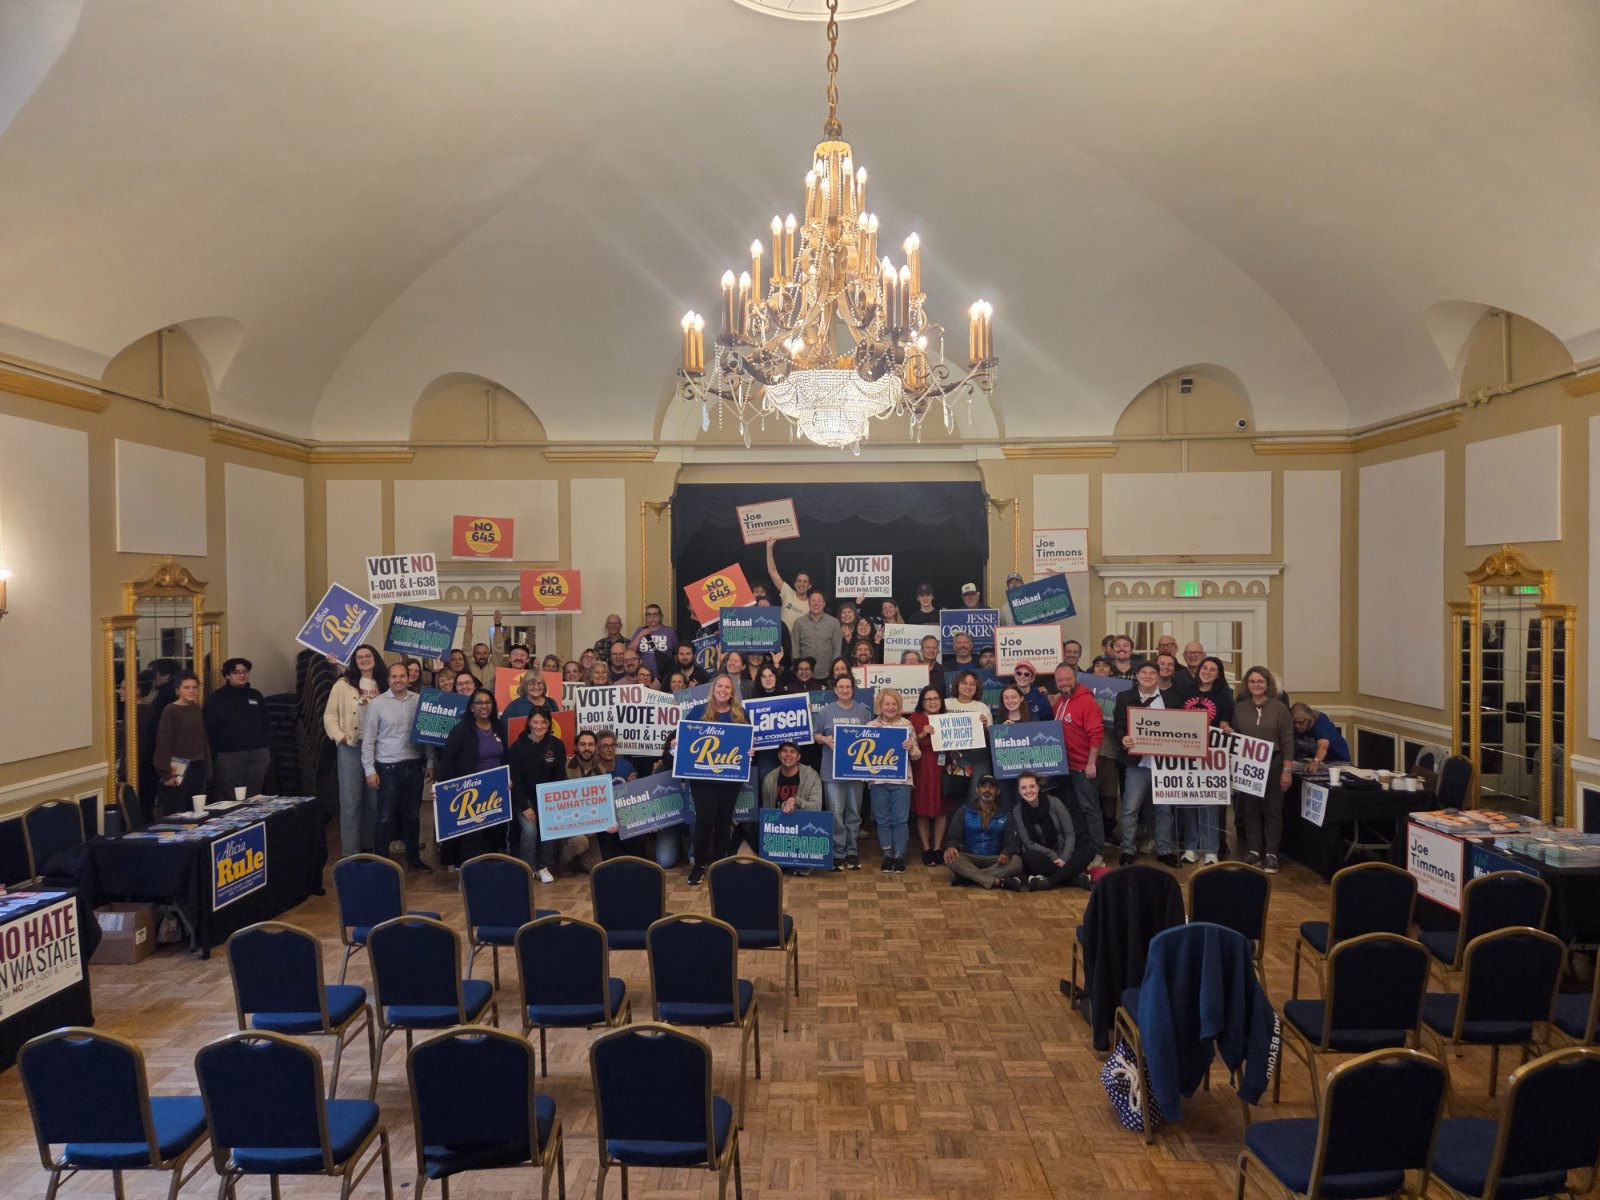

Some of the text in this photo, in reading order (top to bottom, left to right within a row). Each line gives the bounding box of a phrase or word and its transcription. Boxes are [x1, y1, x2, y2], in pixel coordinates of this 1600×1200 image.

[743, 513, 761, 521] Joe
[744, 518, 790, 529] Timmons
[474, 522, 493, 532] NO
[471, 532, 495, 542] 645
[1036, 539, 1055, 547] Joe
[1036, 549, 1082, 557] Timmons
[368, 555, 434, 576] VOTE NO
[838, 557, 890, 572] VOTE NO
[371, 576, 436, 591] I-001 & I-638
[541, 576, 560, 585] NO
[706, 578, 724, 591] NO
[838, 576, 890, 585] I-001 & I-638
[539, 586, 562, 595] 645
[709, 585, 730, 602] 645
[1012, 592, 1041, 607] Michael
[314, 607, 330, 628] Alicia
[321, 603, 361, 642] Rule
[394, 616, 426, 629] Michael
[723, 618, 752, 626] Michael
[966, 613, 997, 624] JESSE
[390, 625, 451, 649] SHEPARD
[723, 627, 778, 642] SHEPARD
[886, 637, 911, 645] CHRIS
[1000, 637, 1022, 646] Joe
[1000, 648, 1055, 657] Timmons
[870, 675, 891, 684] Joe
[577, 688, 616, 707] VOTE
[620, 686, 642, 703] NO
[421, 702, 457, 717] Michael
[616, 705, 680, 725] VOTE NO
[416, 712, 461, 732] SHEP
[579, 711, 614, 723] I-001 &
[750, 709, 807, 731] Larsen
[939, 716, 972, 728] MY UNION
[1136, 717, 1161, 726] Joe
[616, 729, 640, 740] I-001
[643, 729, 650, 740] &
[699, 726, 725, 735] Alicia
[765, 731, 809, 739] CONGRESS
[855, 729, 880, 738] Alicia
[941, 727, 973, 739] MY RIGHT
[1136, 727, 1198, 738] Timmons
[955, 739, 975, 747] VOTE
[995, 736, 1030, 748] Michael
[1209, 729, 1270, 762] OTE NO
[690, 735, 743, 771] Rule
[847, 738, 899, 771] Rule
[996, 745, 1062, 766] SHEPARD
[1153, 750, 1226, 770] VOTE NO
[1234, 761, 1265, 780] I-638
[456, 779, 482, 791] Alicia
[1155, 776, 1227, 788] I-001 & I-638
[1234, 776, 1252, 787] STATE
[544, 784, 606, 803] EDDY URY
[615, 791, 650, 808] Michael
[449, 788, 503, 822] Rule
[557, 796, 607, 810] WHATCOM
[618, 793, 683, 826] SHEPARD
[764, 823, 798, 835] Michael
[217, 839, 246, 862] Alicia
[763, 834, 829, 856] SHEPARD
[1411, 839, 1429, 855] Joe
[217, 848, 264, 888] Rule
[1411, 852, 1455, 882] Timmons
[24, 903, 76, 952] HATE
[10, 953, 35, 985] WA
[36, 933, 78, 972] STATE
[0, 990, 11, 1001] ote
[12, 983, 24, 994] NO
[35, 969, 53, 983] I-001
[1266, 1011, 1281, 1080] AND BEYOND
